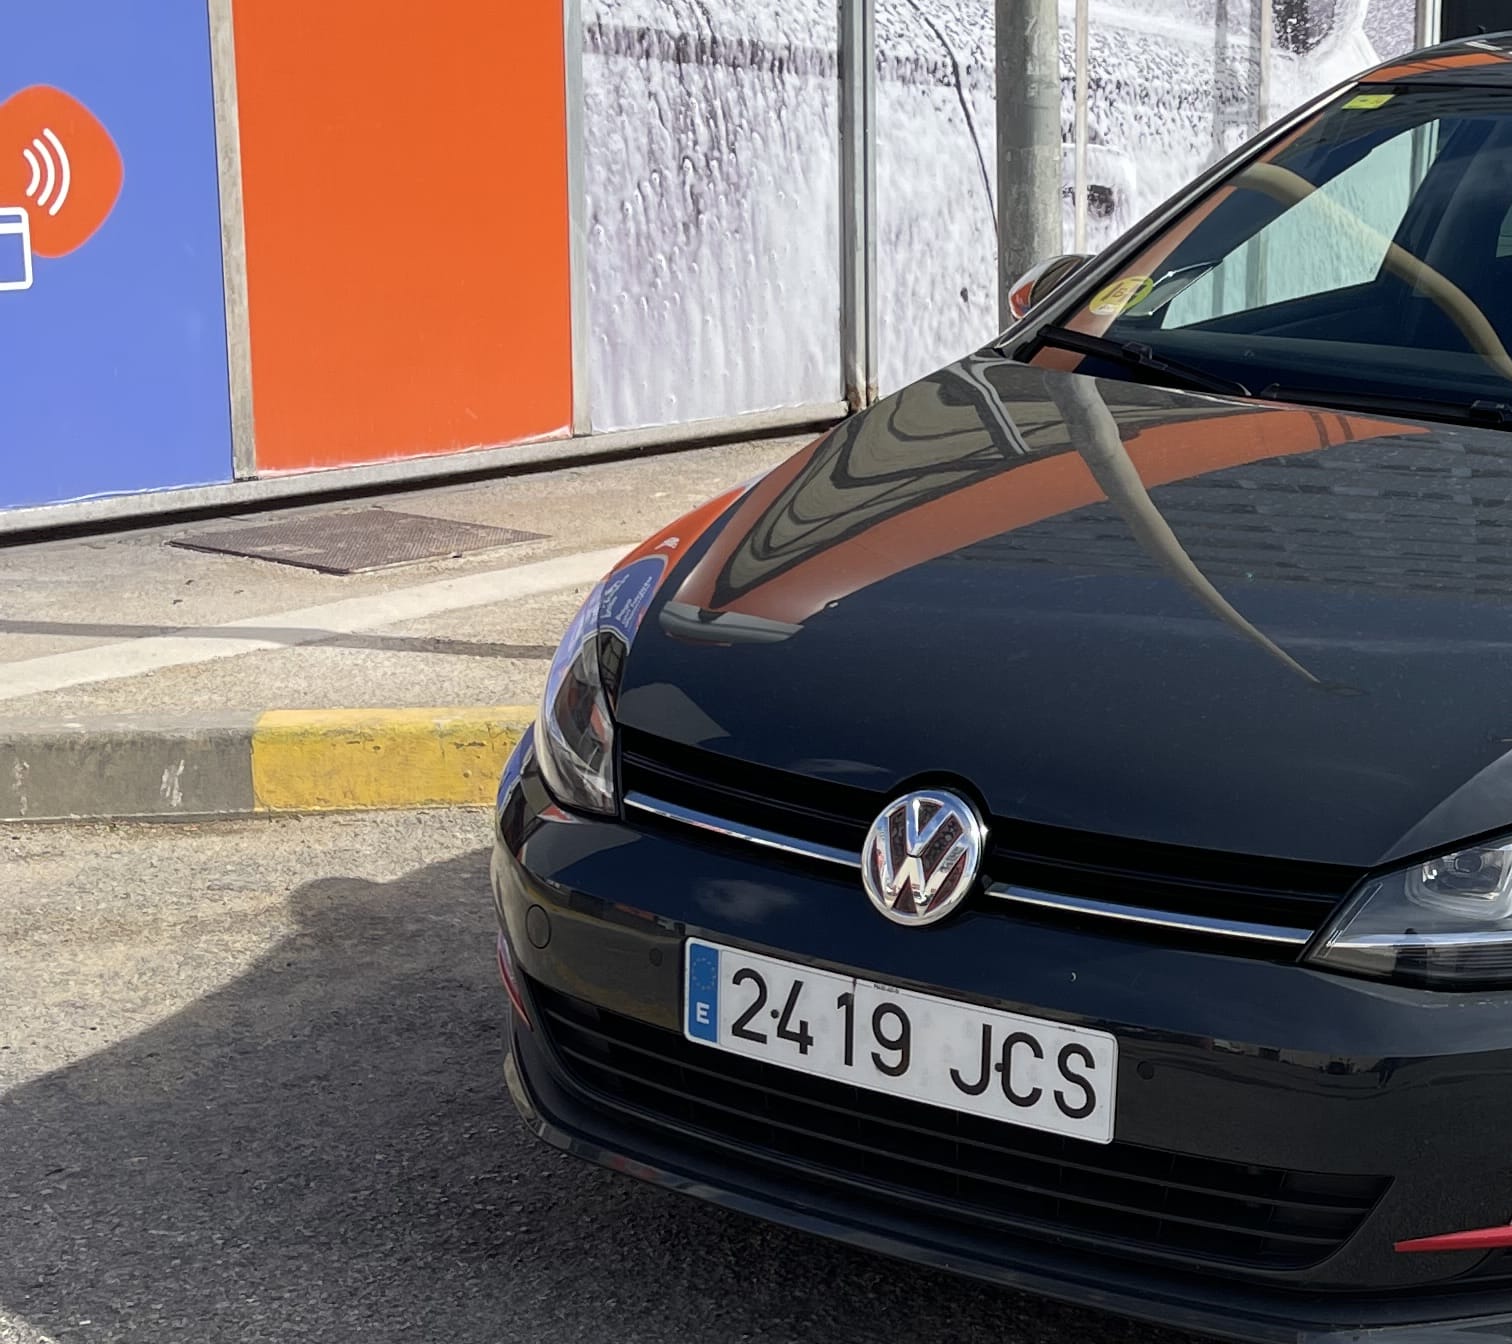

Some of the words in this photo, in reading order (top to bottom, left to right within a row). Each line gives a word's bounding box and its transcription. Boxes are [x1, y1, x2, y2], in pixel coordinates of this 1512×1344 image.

[696, 1002, 710, 1024] E
[731, 967, 912, 1077] 2419
[949, 1023, 1097, 1119] JCS
